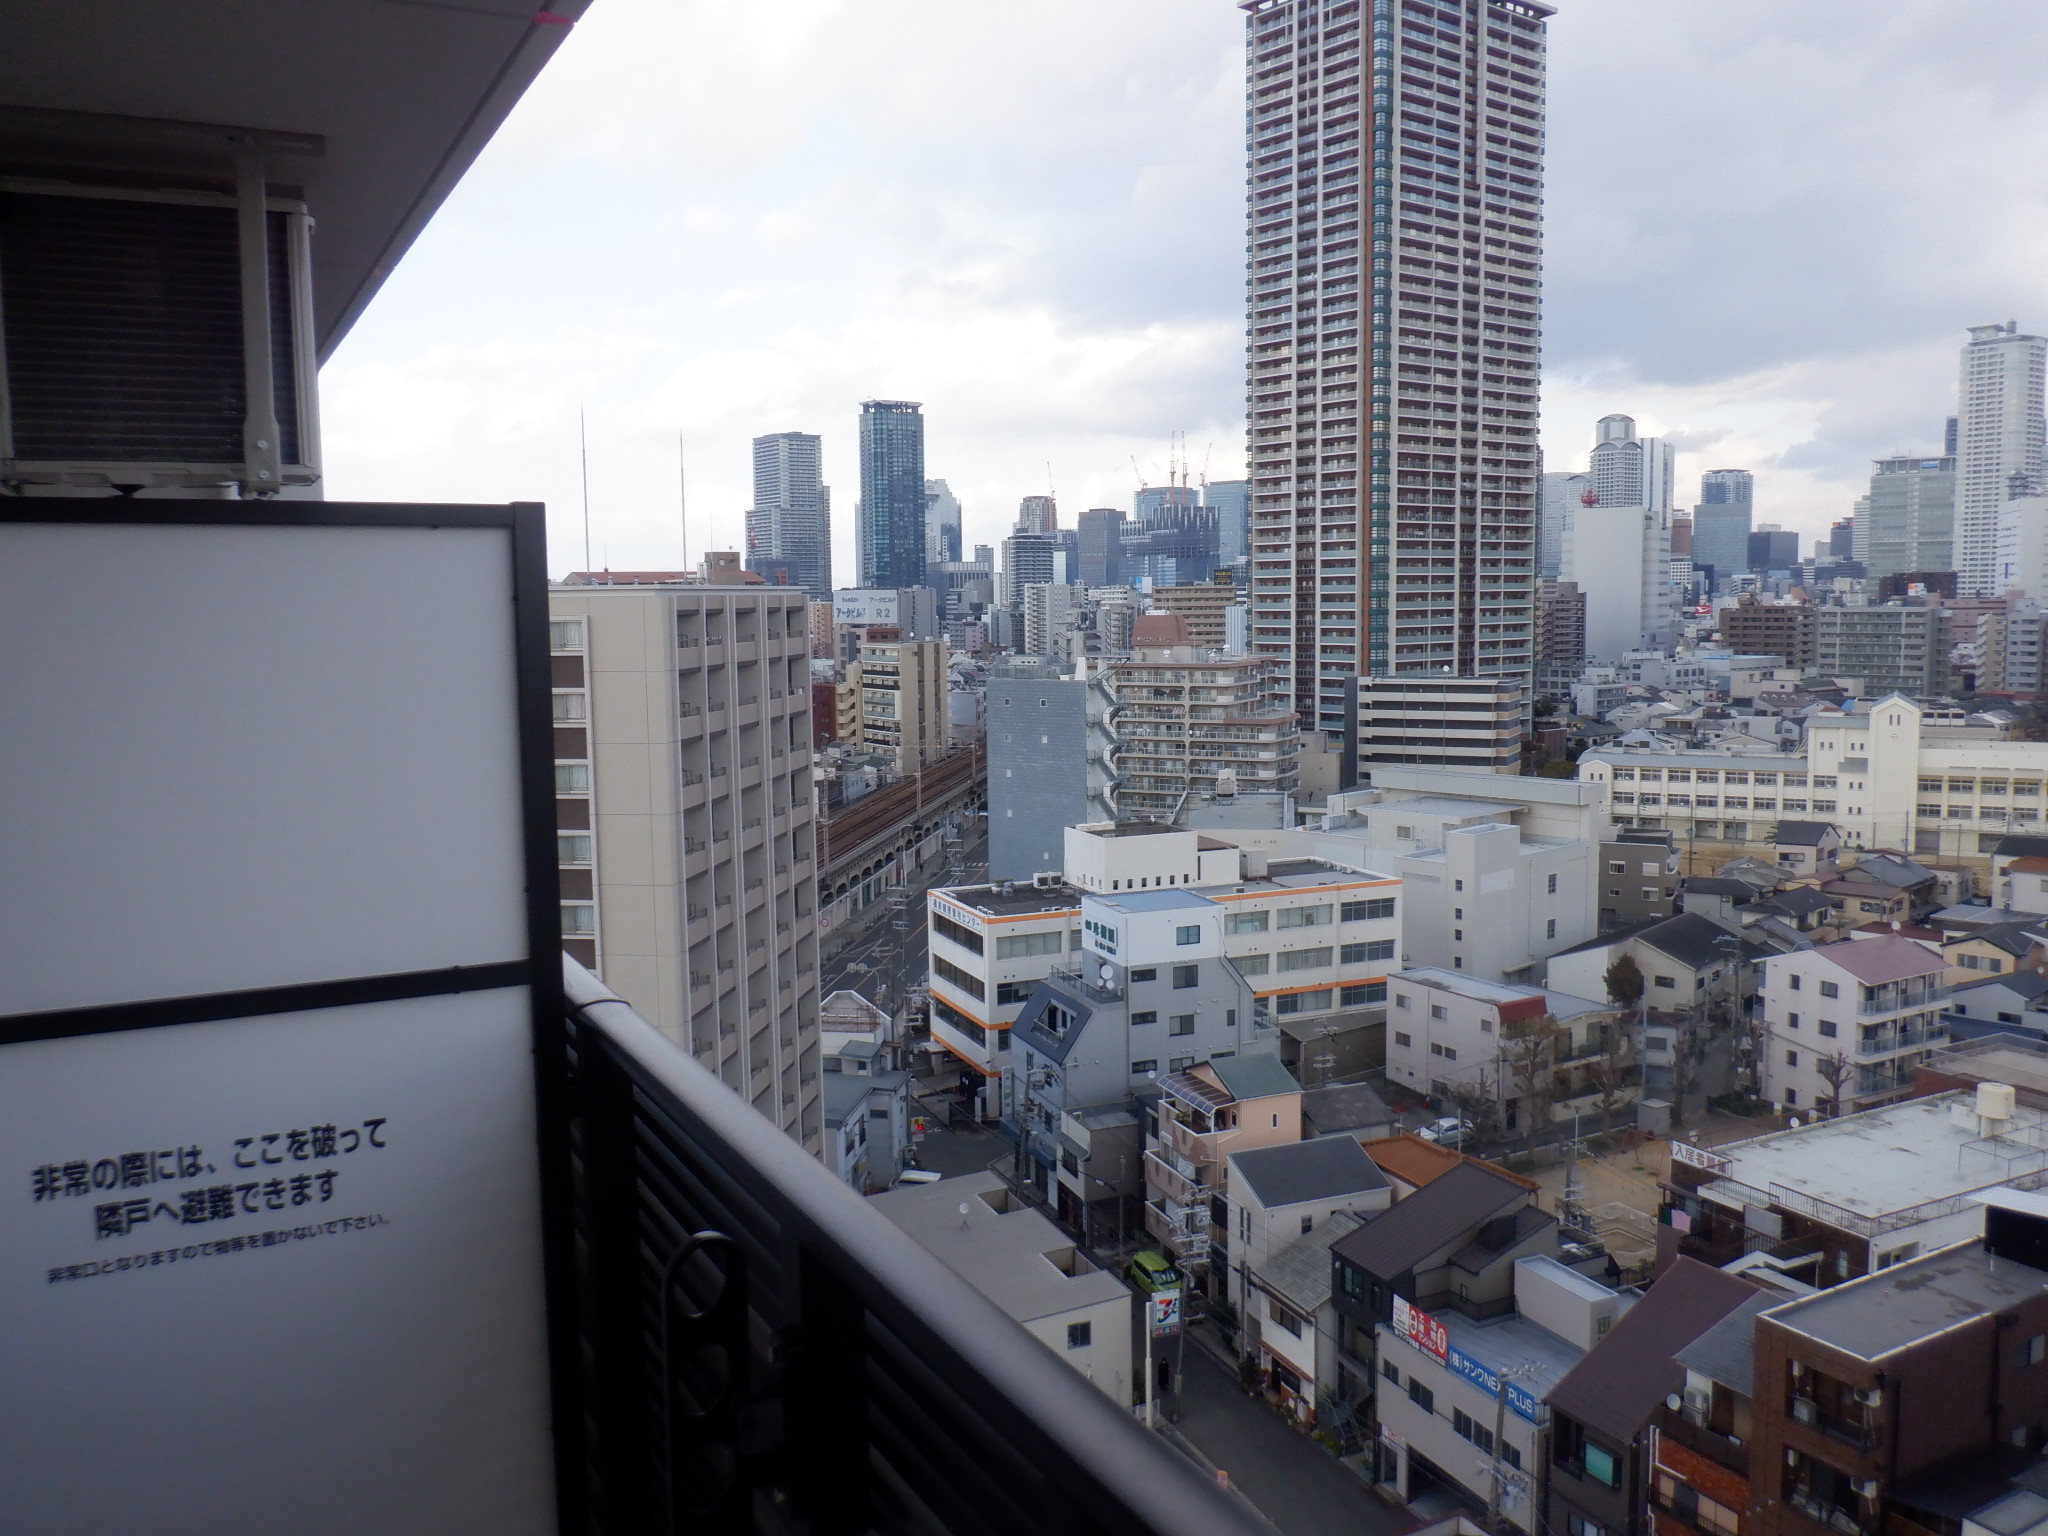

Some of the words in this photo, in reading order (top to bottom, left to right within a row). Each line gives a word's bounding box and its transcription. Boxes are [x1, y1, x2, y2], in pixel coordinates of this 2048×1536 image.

[31, 1117, 388, 1202] 非常の際には、ここを破って
[94, 1168, 340, 1241] 隣戸へ避難できます
[1449, 1350, 1508, 1392] (株)サンワNEX
[1508, 1387, 1533, 1413] PLUS
